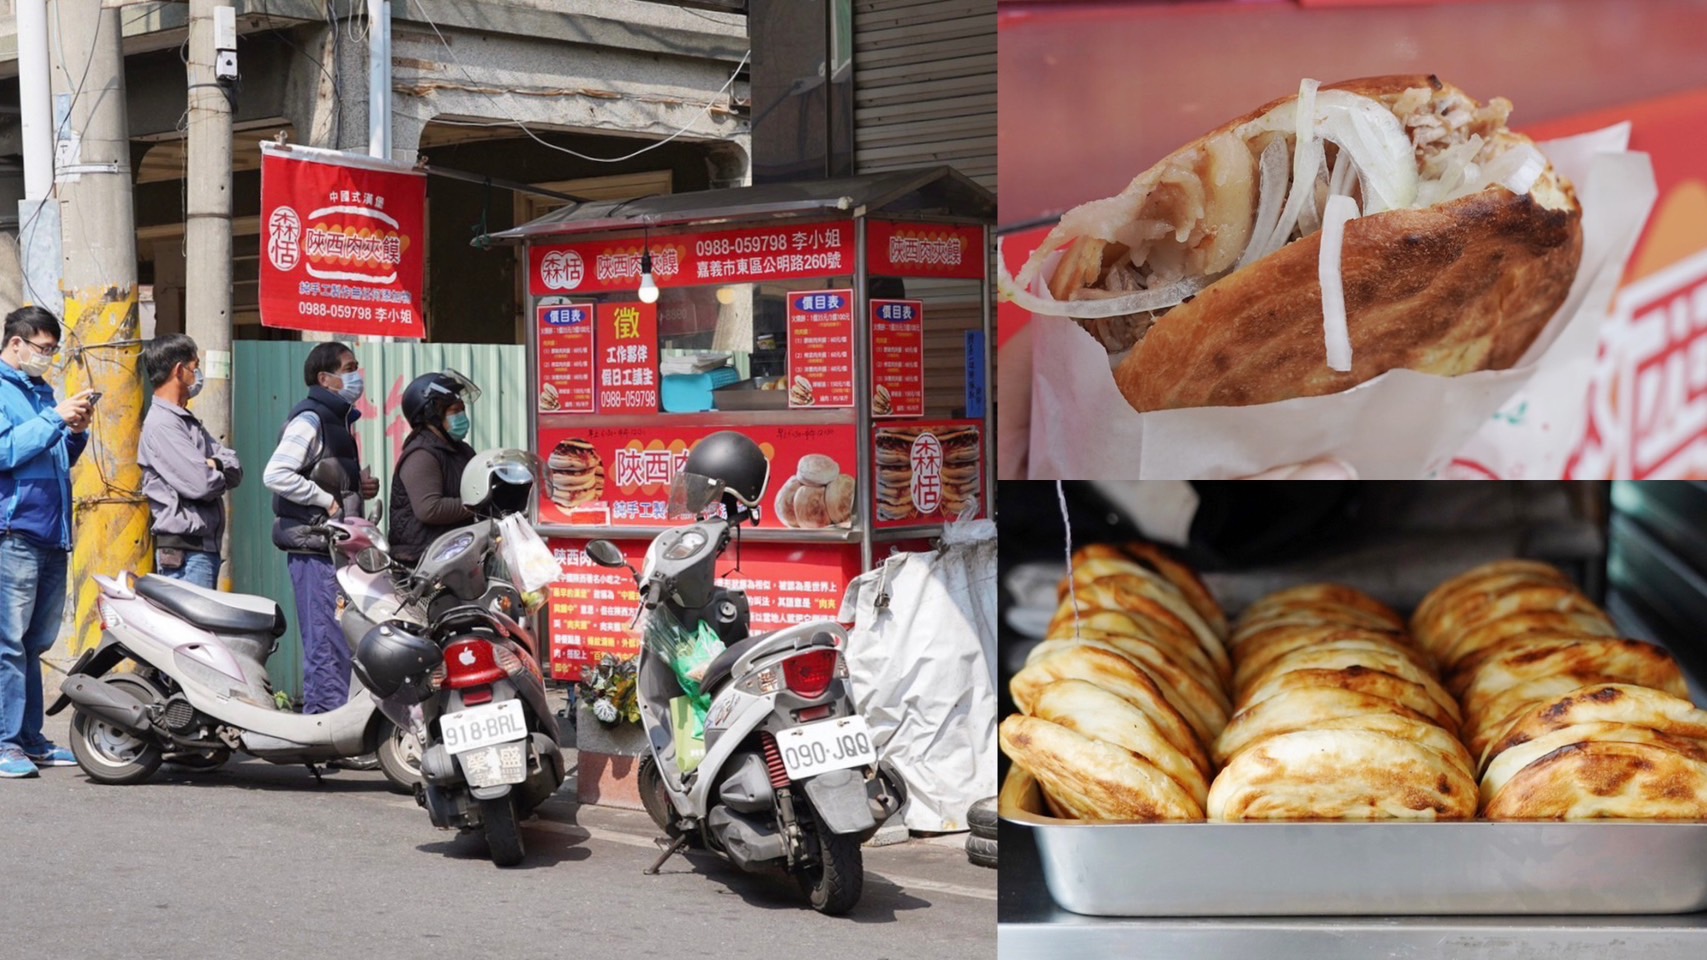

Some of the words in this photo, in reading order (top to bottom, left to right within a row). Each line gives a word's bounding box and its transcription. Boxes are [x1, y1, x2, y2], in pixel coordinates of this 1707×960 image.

[696, 234, 787, 257] 0988-059798
[792, 229, 841, 251] 李小姐
[696, 251, 842, 278] 嘉義市東區公明路260號
[299, 301, 372, 321] 0988-059798
[375, 308, 412, 324] 李小姐
[802, 295, 839, 311] 價目表
[882, 304, 912, 320] 價目表
[549, 309, 581, 323] 價目表
[614, 307, 640, 340] 徵
[606, 344, 648, 364] 工作夥伴
[602, 367, 654, 386] 假日工讀生
[601, 390, 656, 408] 0988-059798
